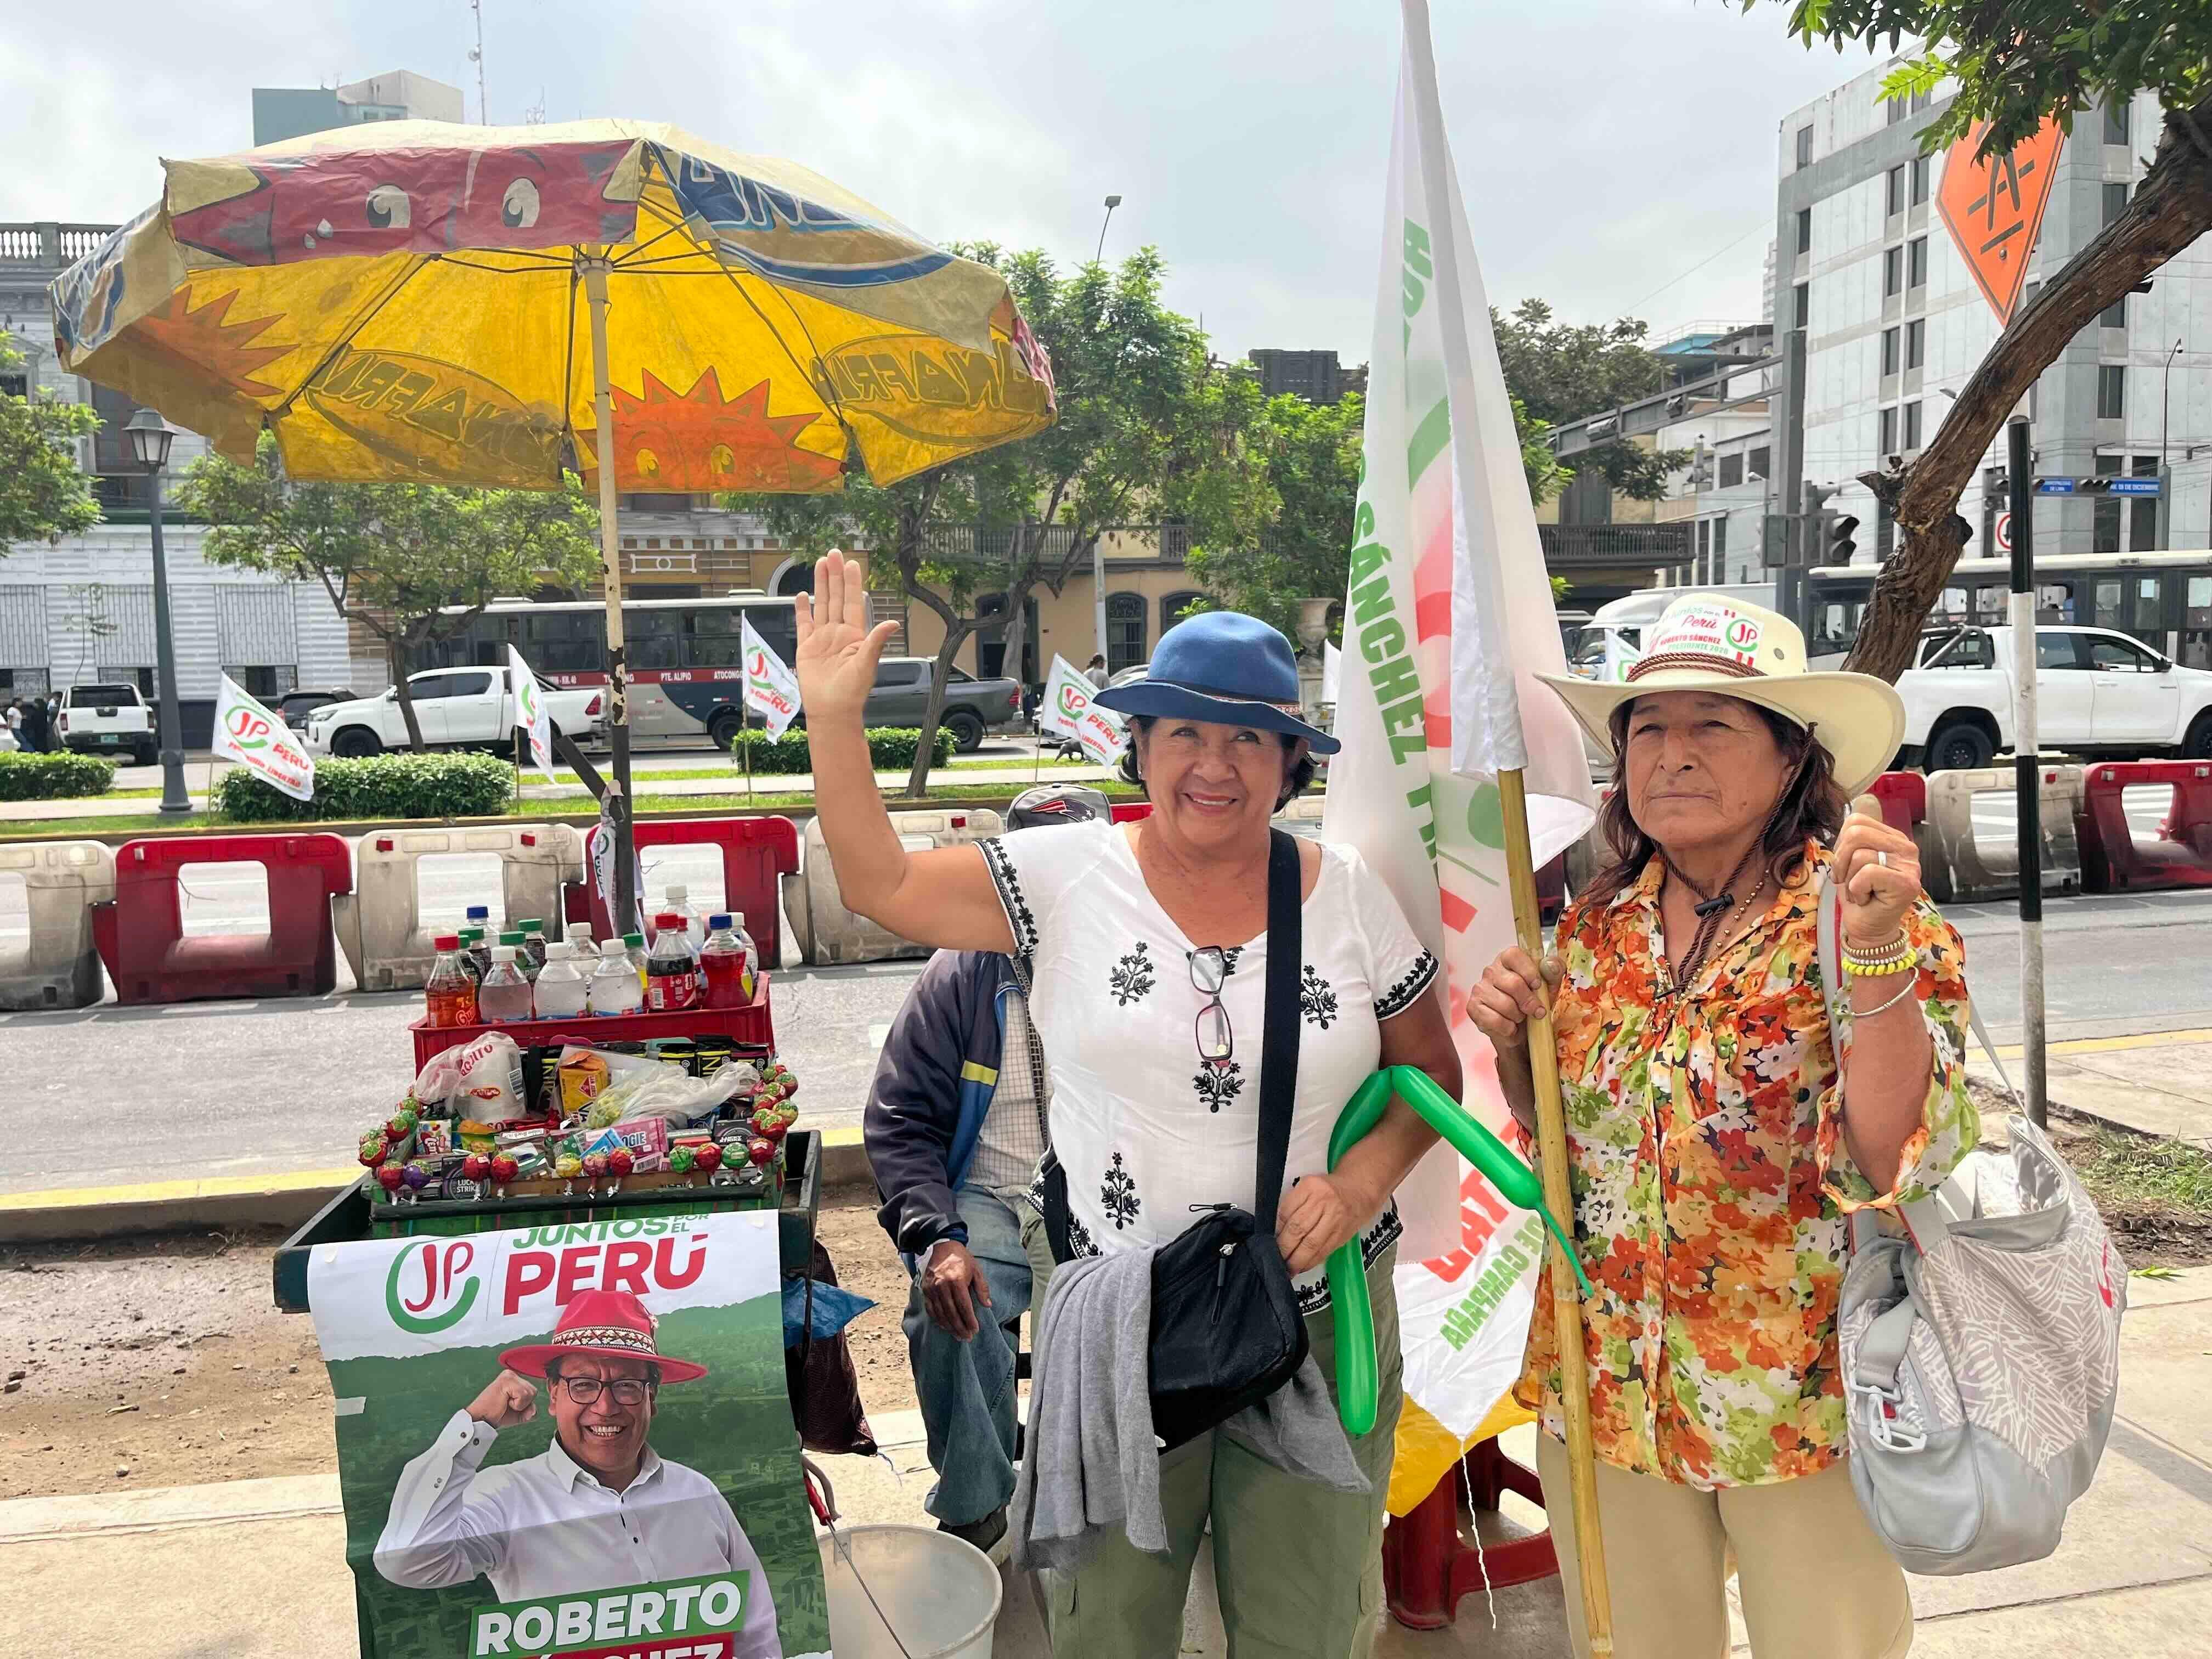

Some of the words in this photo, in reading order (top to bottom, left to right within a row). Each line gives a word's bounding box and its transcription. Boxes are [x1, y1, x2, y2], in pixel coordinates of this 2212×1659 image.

[1351, 501, 1429, 766] SÁNCHEZ
[1660, 634, 1688, 646] ROBERTO
[1689, 633, 1722, 645] SÁNCHEZ
[1732, 624, 1757, 644] JP
[674, 672, 692, 681] ALIPIO
[233, 711, 270, 737] JP
[513, 1217, 669, 1249] JUNTOS
[671, 1222, 690, 1233] EL
[404, 1242, 474, 1312] JP
[503, 1233, 708, 1316] PERÚ
[476, 1580, 742, 1656] ROBERTO
